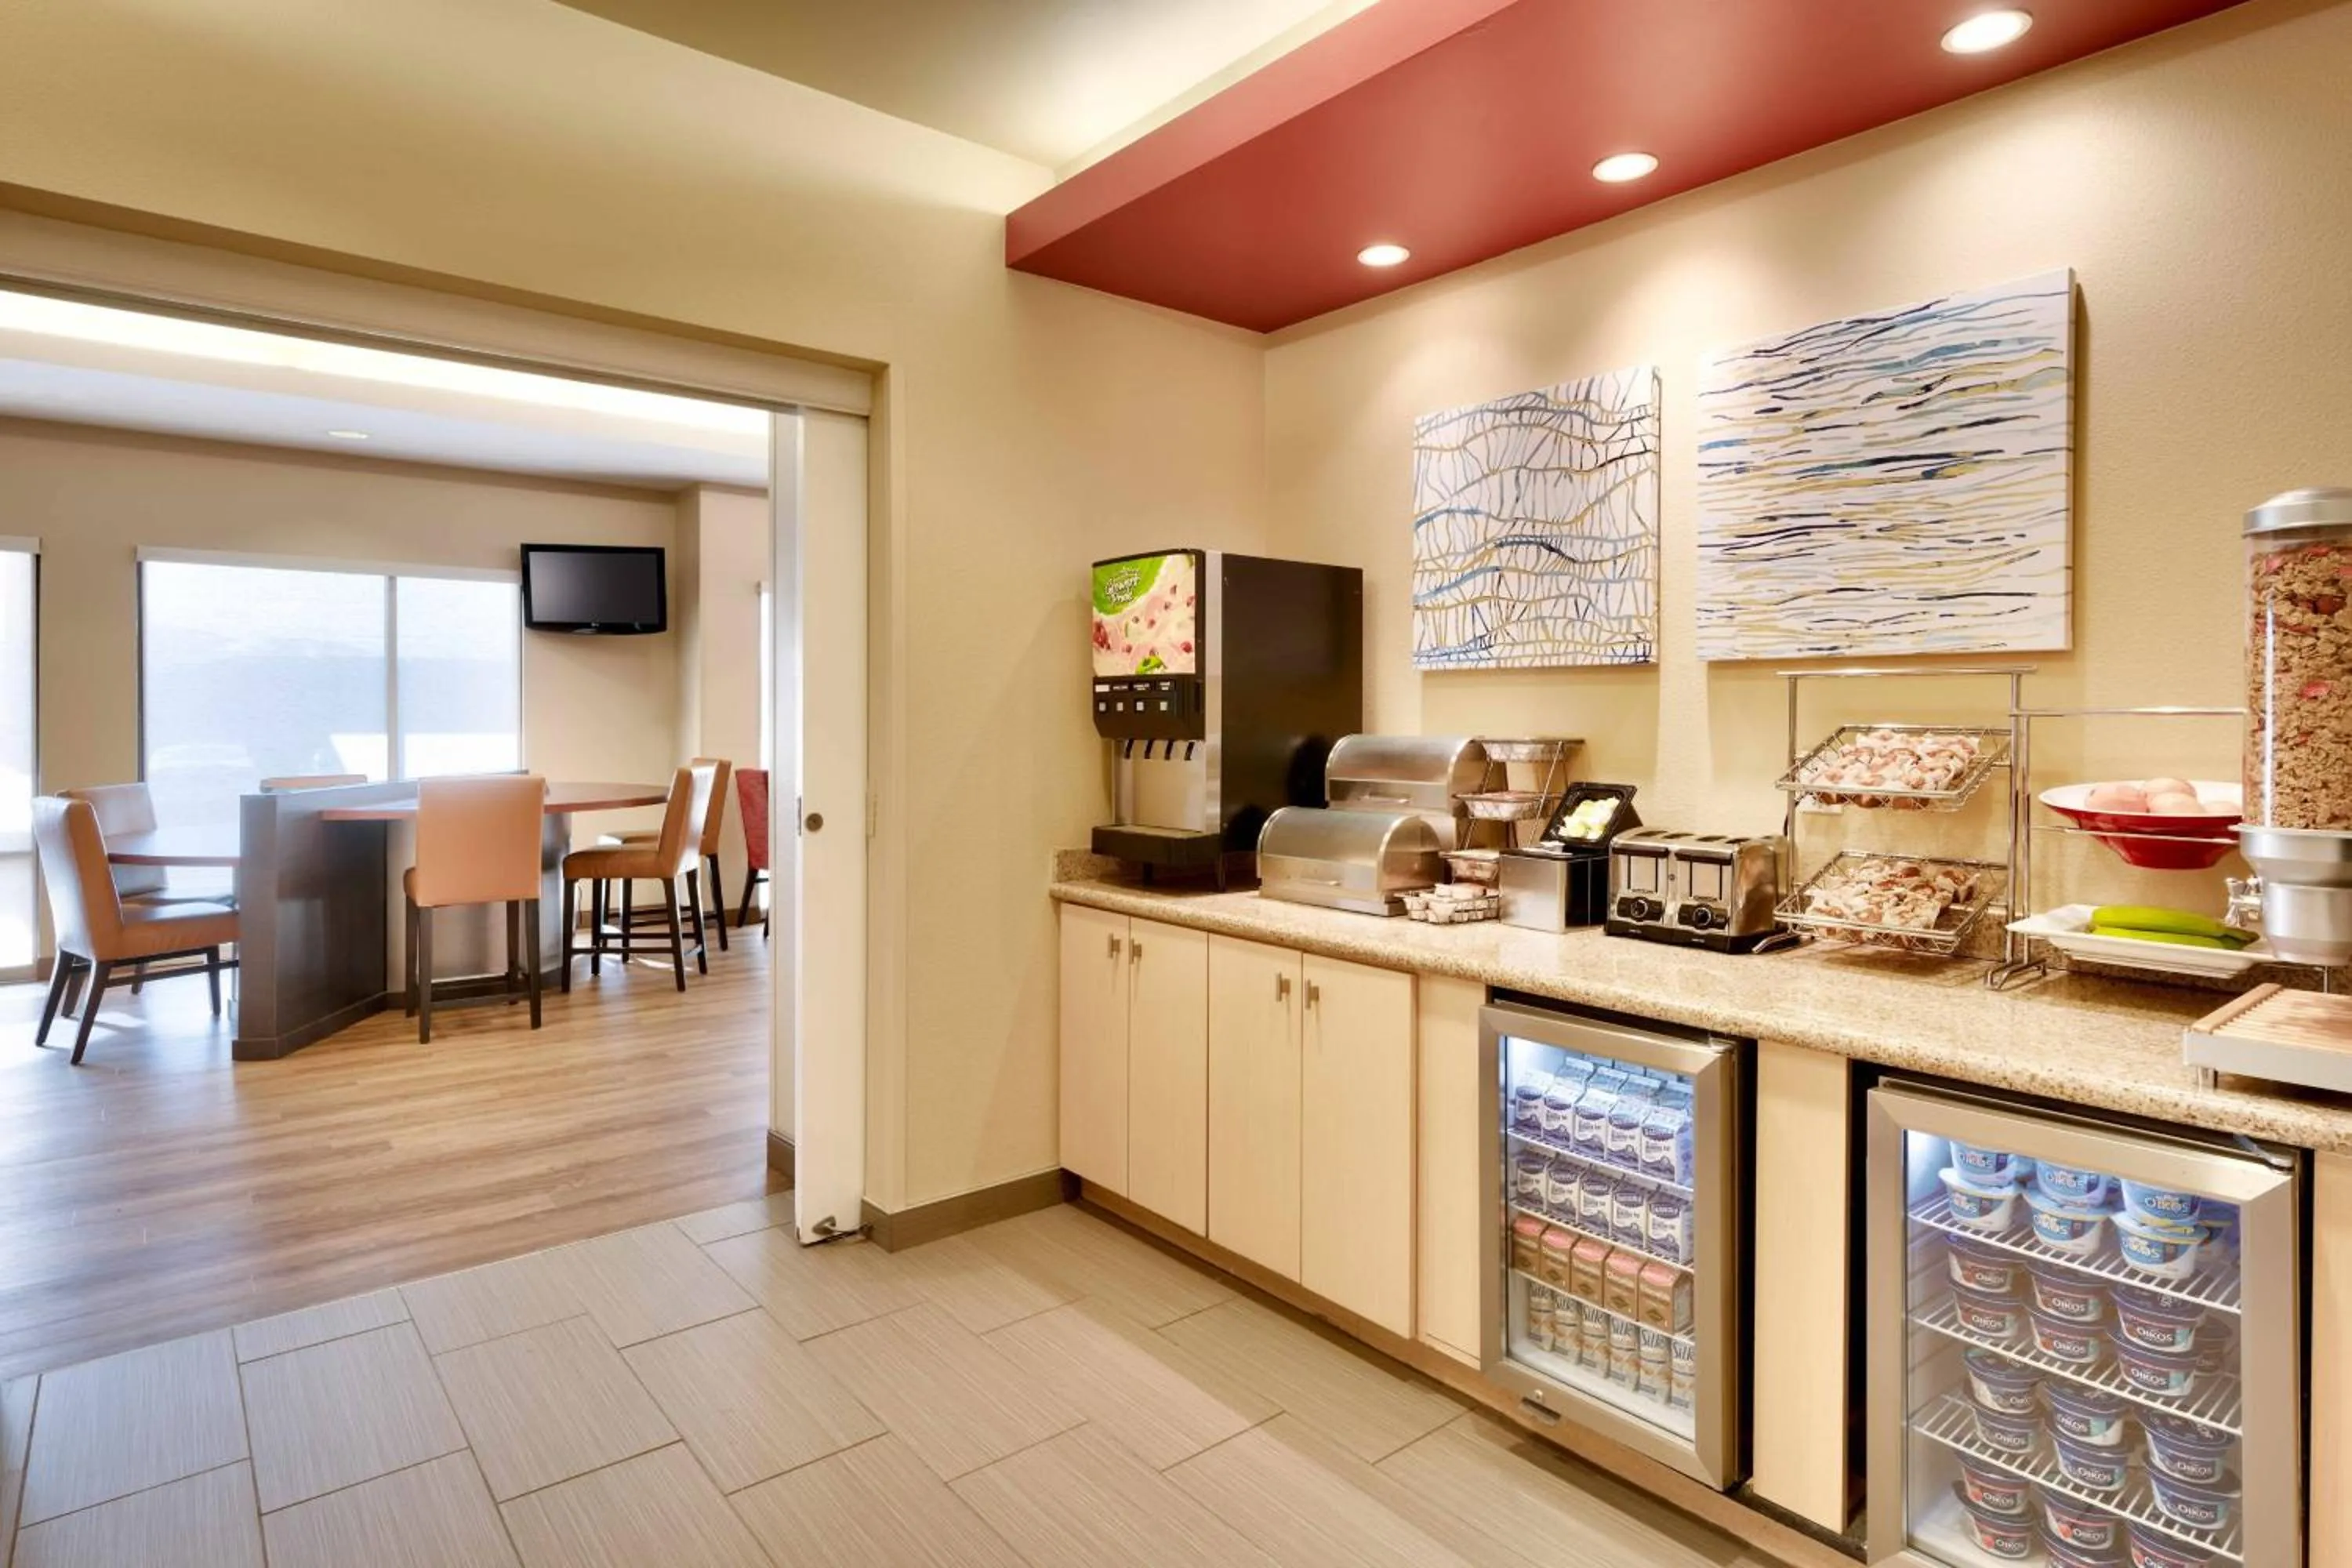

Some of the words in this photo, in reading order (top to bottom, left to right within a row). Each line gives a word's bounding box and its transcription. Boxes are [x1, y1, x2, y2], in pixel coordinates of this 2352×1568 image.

[2144, 1196, 2190, 1214] OIKOS
[2052, 1298, 2086, 1313] OIKOS
[1641, 1329, 1665, 1348] Silk
[2136, 1326, 2173, 1343] OIKOS
[2054, 1339, 2086, 1355] OIKOS
[2131, 1367, 2167, 1387] OIKOS
[2078, 1467, 2113, 1483] OIKOS
[2177, 1461, 2212, 1475] OIKOS
[2177, 1504, 2215, 1519] OIKOS
